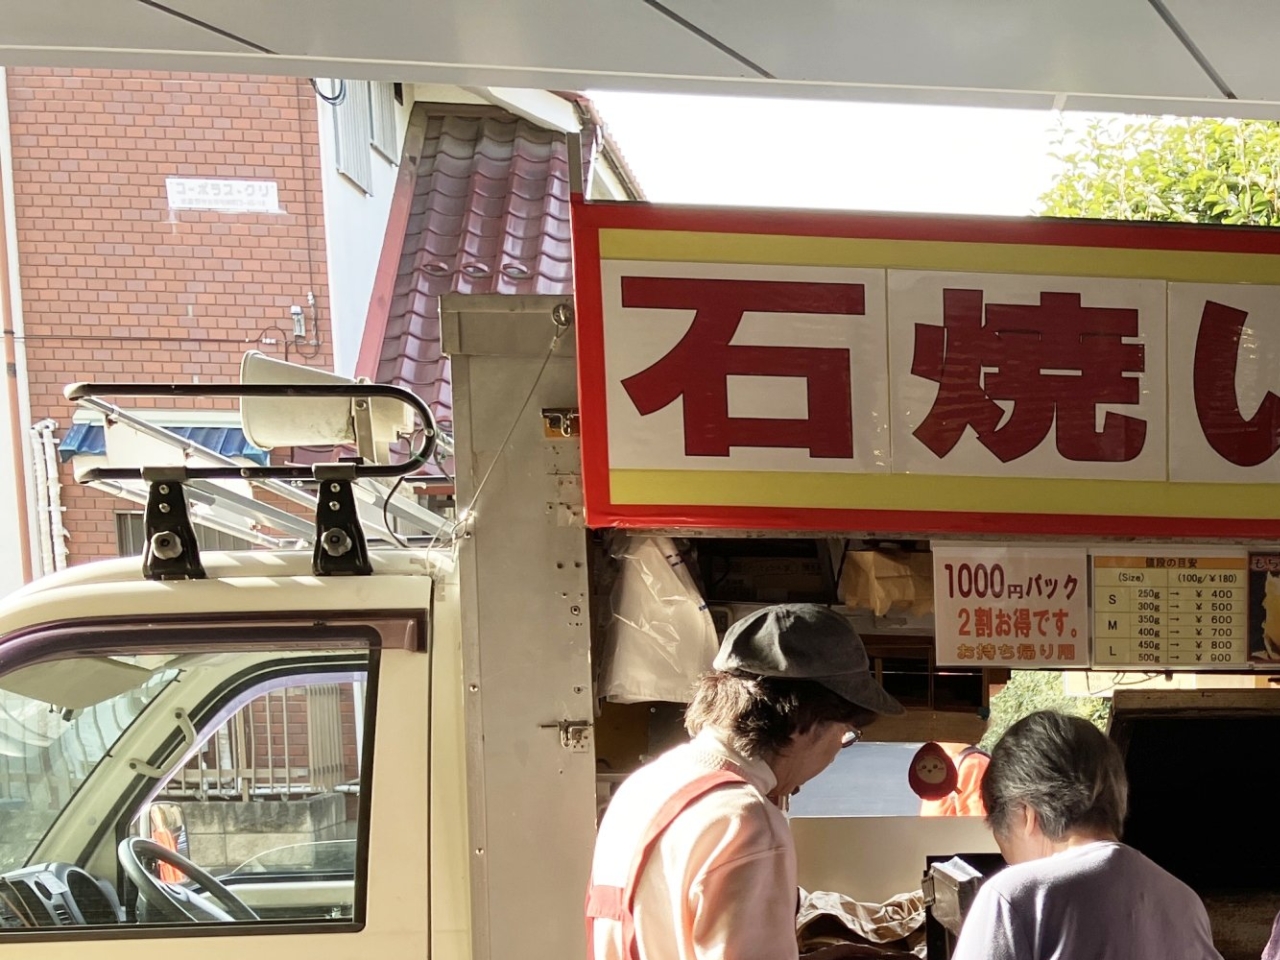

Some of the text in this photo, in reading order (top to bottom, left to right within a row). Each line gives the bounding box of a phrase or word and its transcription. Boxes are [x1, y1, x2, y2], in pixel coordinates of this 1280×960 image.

[1145, 557, 1198, 568] 値段の目安
[944, 562, 1079, 600] 1000円パック
[1118, 572, 1145, 583] (Size)
[1138, 590, 1160, 599] 250g
[1211, 590, 1233, 598] 400
[1109, 595, 1117, 605] S
[1138, 603, 1160, 612] 300g
[1211, 603, 1233, 611] 500
[958, 608, 1078, 638] 2割お得です。
[1138, 615, 1160, 624] 350g
[1211, 615, 1233, 623] 600
[1108, 620, 1118, 630] M
[1138, 628, 1160, 637] 400g
[1211, 628, 1233, 636] 700
[1138, 641, 1160, 650] 450g
[1211, 641, 1233, 649] 800
[957, 643, 1075, 660] お持ち帰り用
[1110, 647, 1117, 656] L
[1138, 653, 1160, 662] 500g
[1211, 653, 1233, 661] 900
